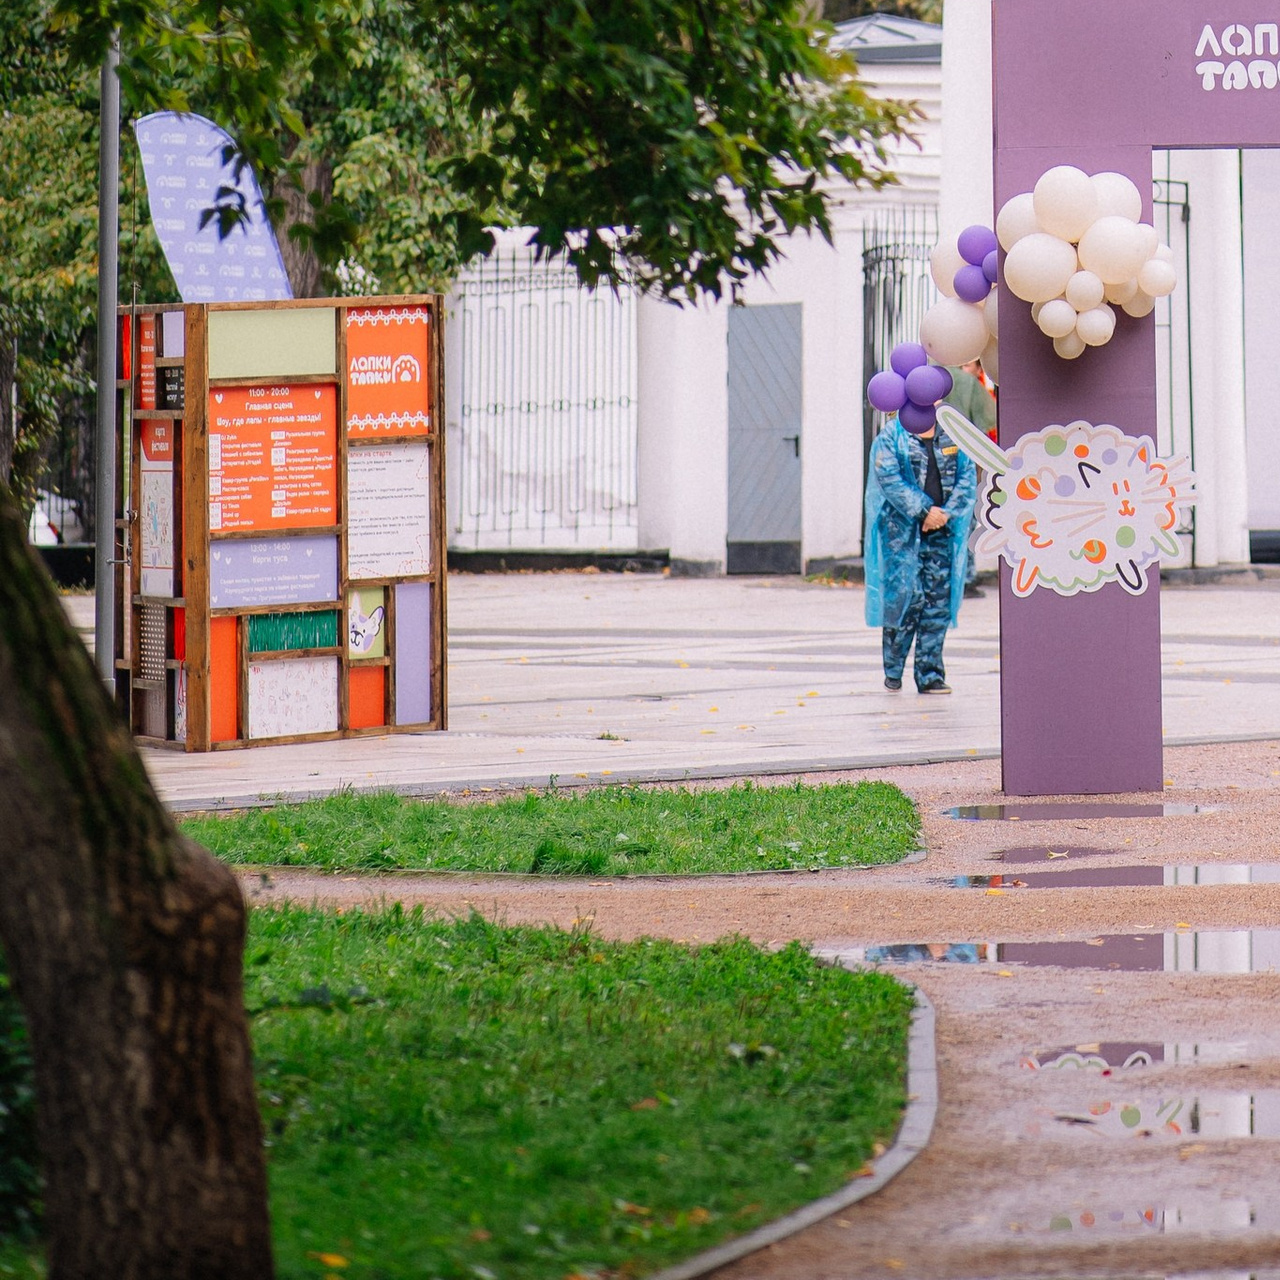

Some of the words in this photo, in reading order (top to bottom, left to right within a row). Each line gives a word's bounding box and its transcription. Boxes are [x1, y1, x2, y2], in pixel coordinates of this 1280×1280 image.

[350, 356, 391, 371] ЛАПКИ
[350, 371, 391, 386] ТАПКИ
[249, 389, 265, 397] 11:00
[271, 388, 290, 396] 20:00
[245, 402, 272, 411] Главная
[273, 402, 293, 412] сцена
[232, 418, 244, 427] где
[246, 417, 262, 425] лапы
[268, 415, 295, 424] главные
[296, 413, 321, 424] звезды!
[373, 450, 392, 458] старте
[252, 556, 271, 565] Корги
[273, 555, 288, 565] туса
